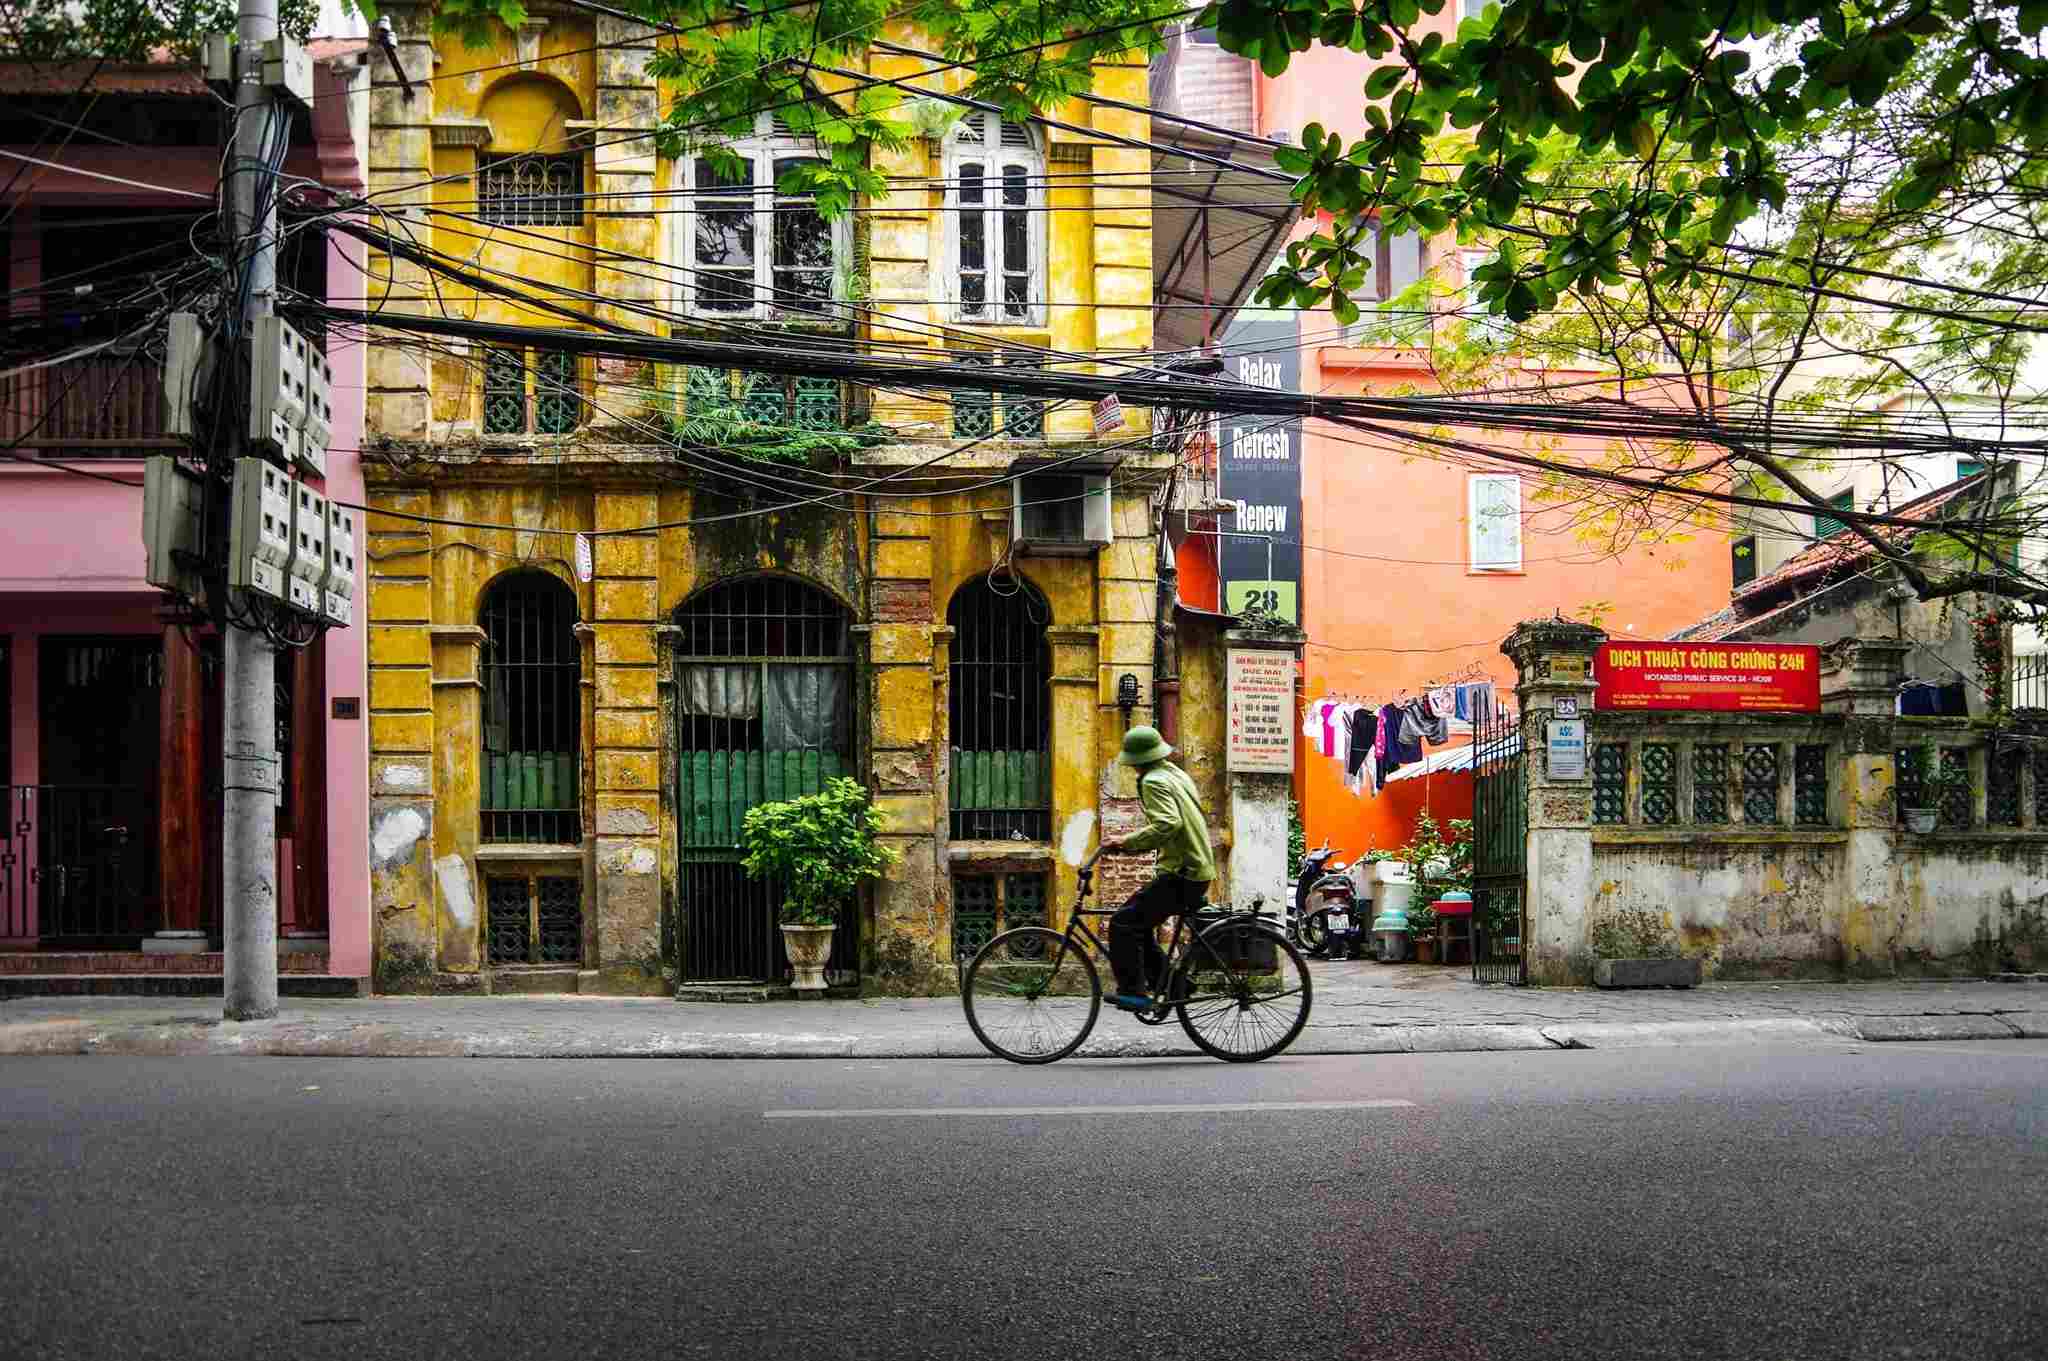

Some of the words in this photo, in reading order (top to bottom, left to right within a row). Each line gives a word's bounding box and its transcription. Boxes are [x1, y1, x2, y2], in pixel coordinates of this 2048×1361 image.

[1239, 356, 1281, 389] Relax
[1233, 427, 1290, 459] Refresh
[1236, 499, 1287, 531] Renew
[1245, 590, 1279, 611] 28
[1609, 649, 1641, 671] DỊCH
[1644, 648, 1687, 671] THUẬT
[1690, 648, 1728, 670] CÔNG
[1731, 648, 1776, 670] CHỨNG
[1779, 653, 1805, 671] 24H
